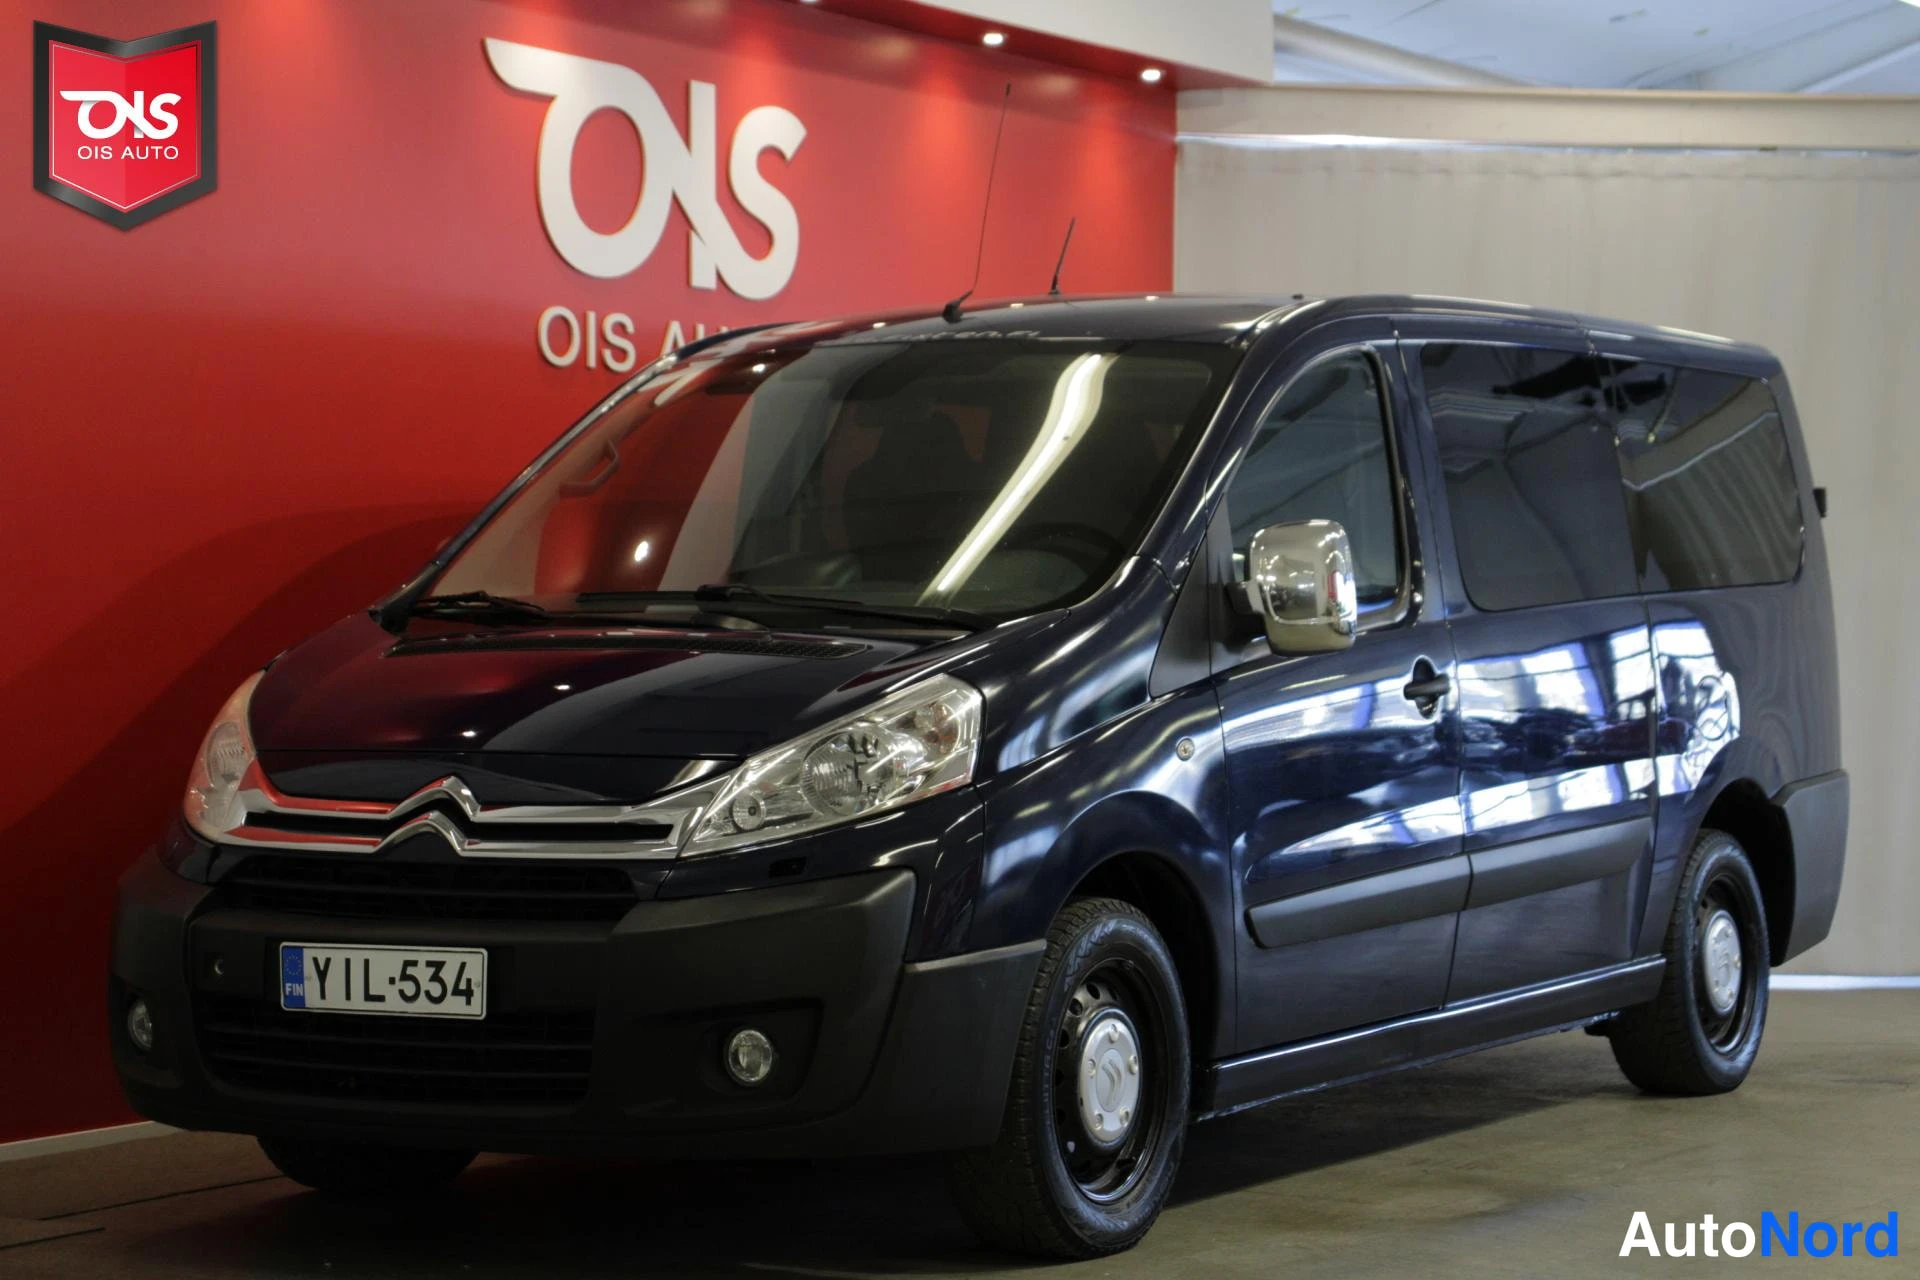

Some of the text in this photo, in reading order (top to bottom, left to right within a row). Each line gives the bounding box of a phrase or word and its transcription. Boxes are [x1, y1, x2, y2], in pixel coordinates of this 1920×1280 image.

[484, 37, 807, 300] OIS
[537, 306, 636, 372] OIS
[285, 982, 304, 997] FIN
[312, 957, 474, 1006] YIL-534
